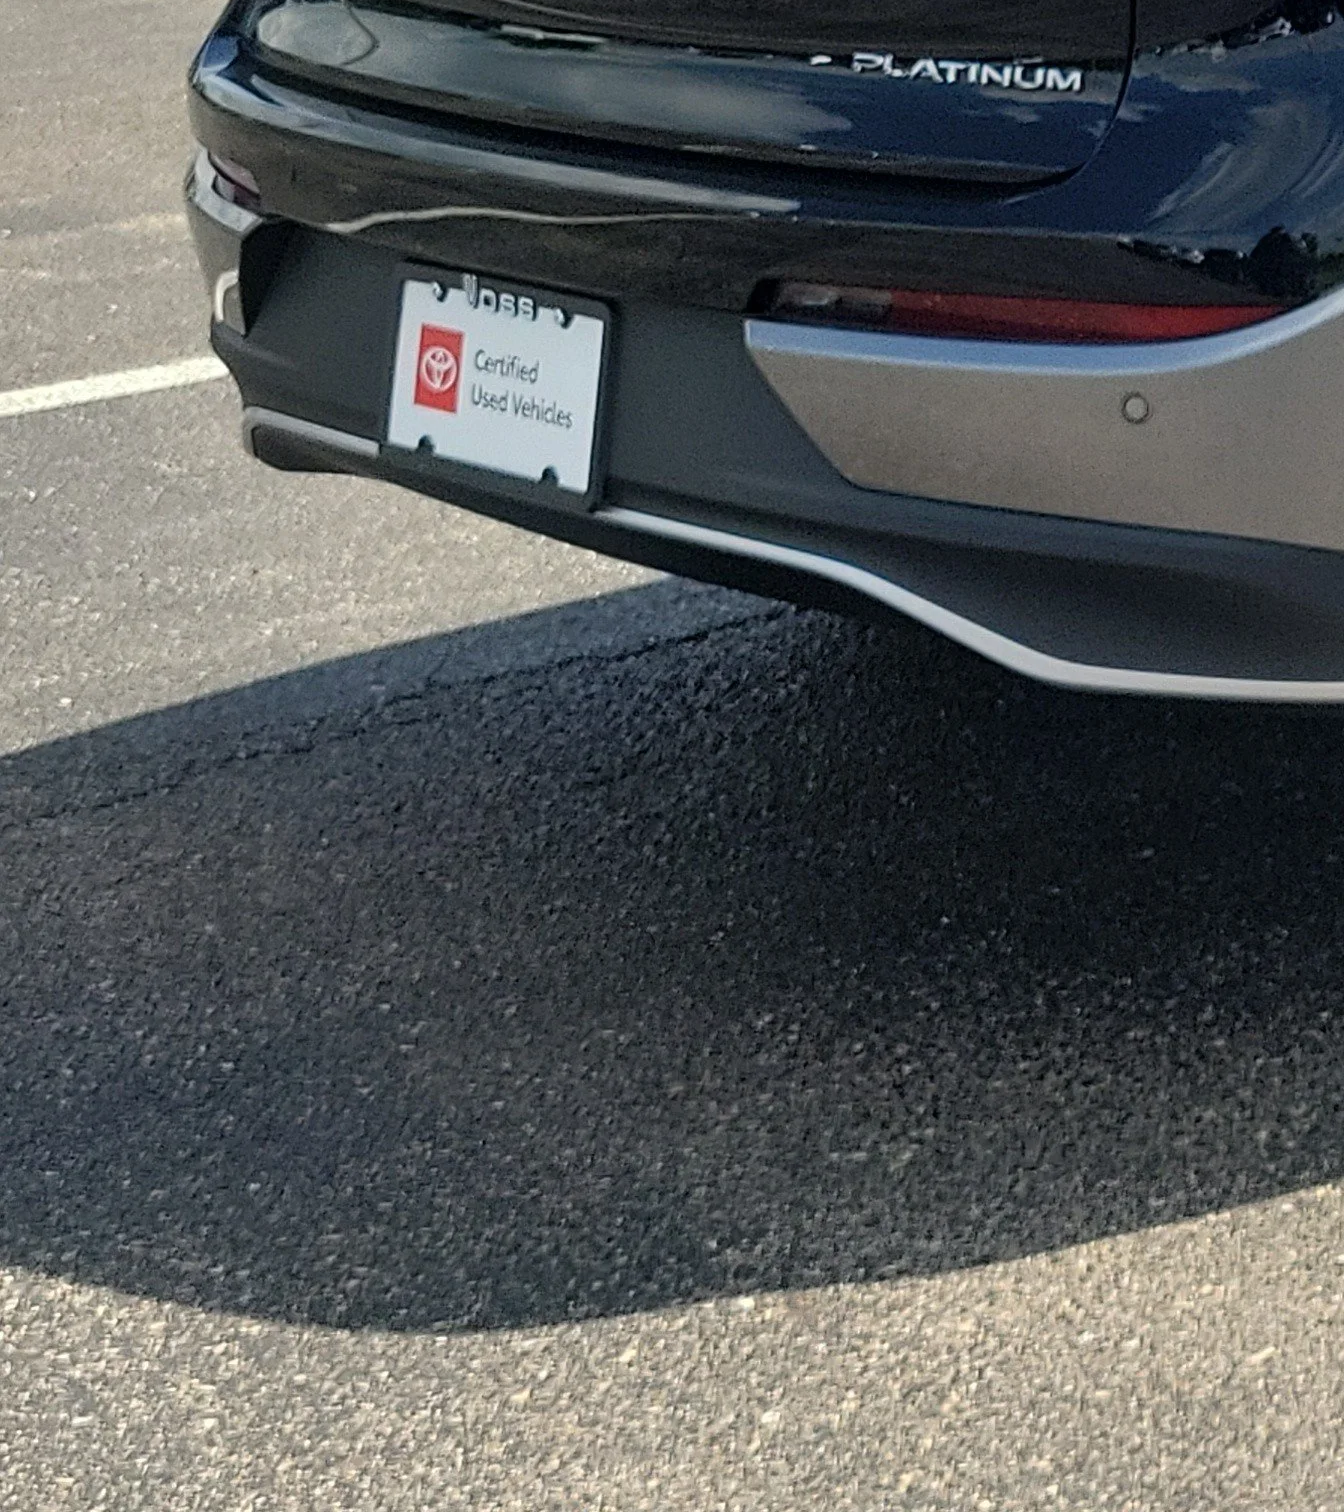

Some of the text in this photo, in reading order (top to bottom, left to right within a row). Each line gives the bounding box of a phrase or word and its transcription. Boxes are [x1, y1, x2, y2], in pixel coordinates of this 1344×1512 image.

[851, 51, 1083, 93] PLATINUM
[474, 348, 540, 384] Certified
[471, 383, 574, 429] Used Vehicles
